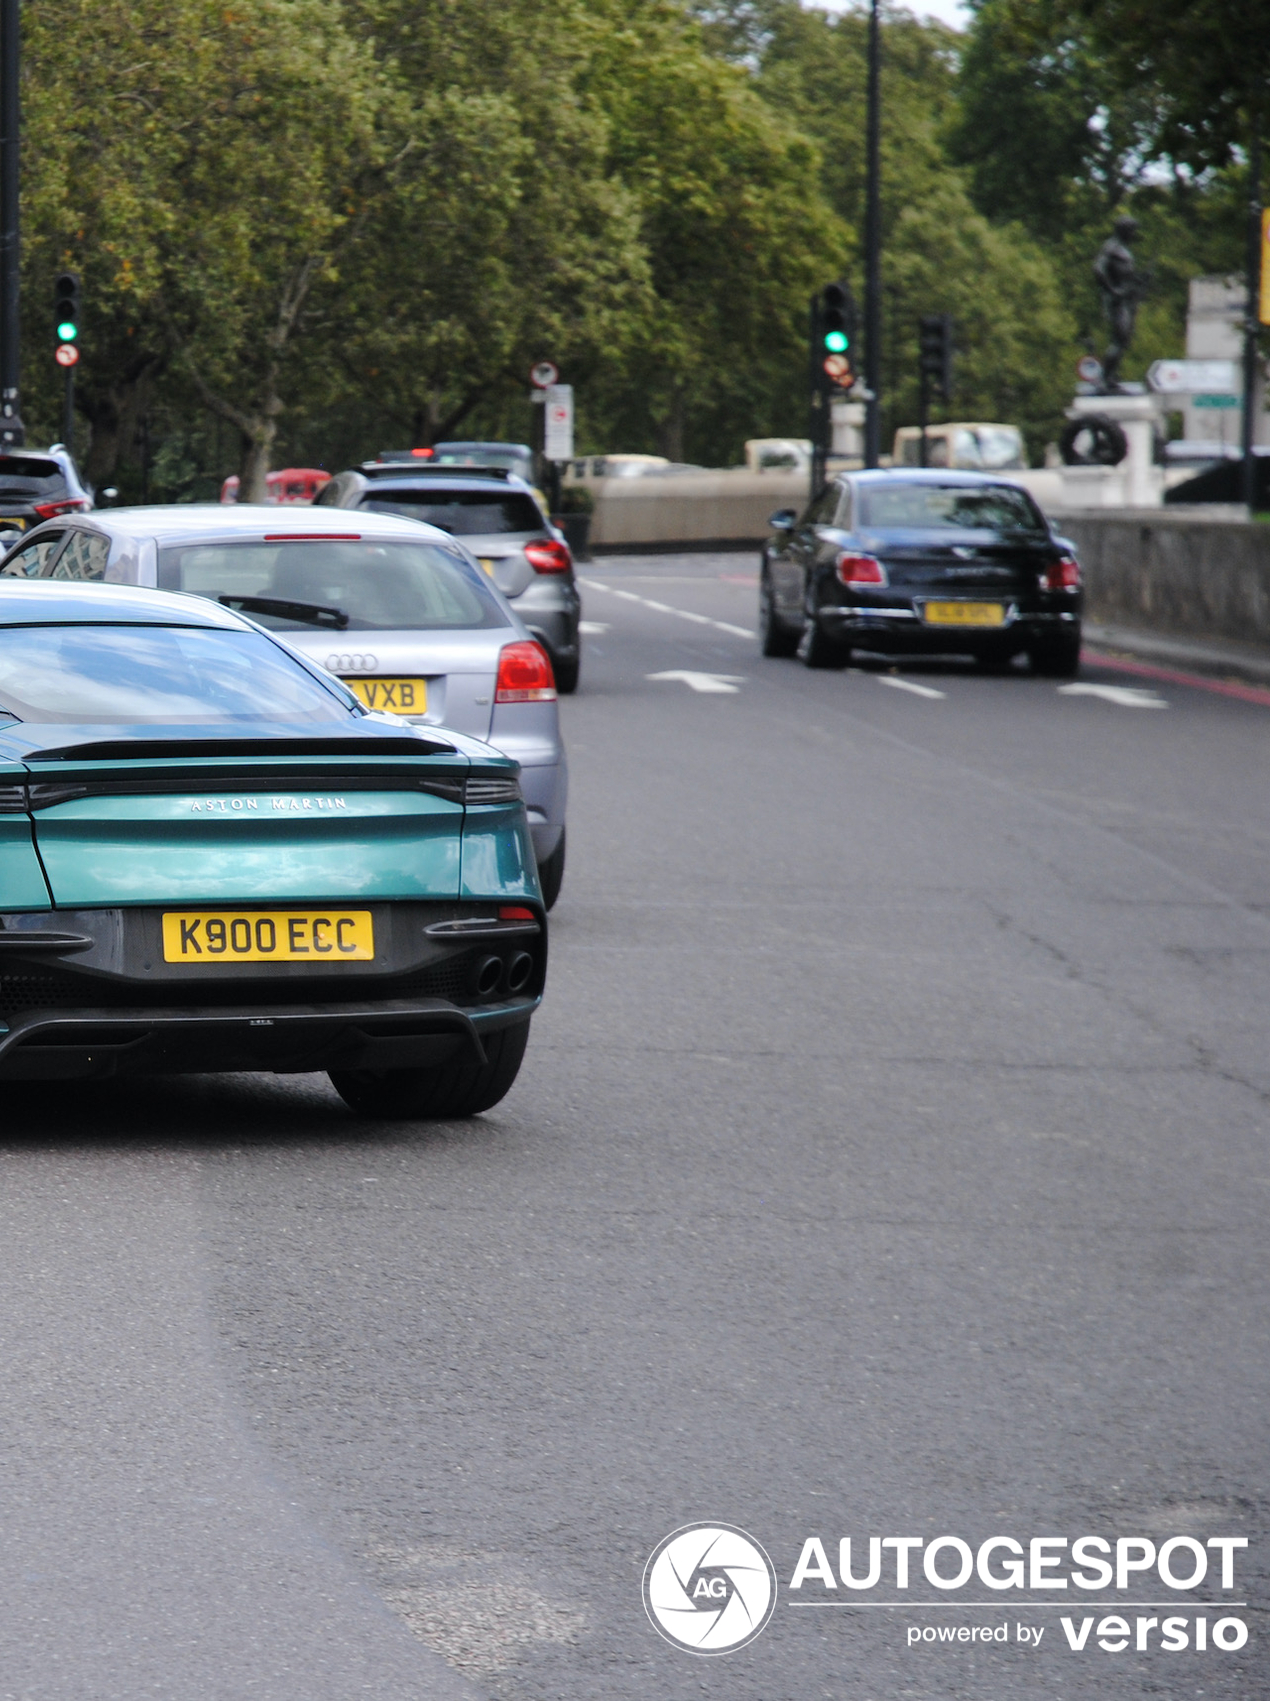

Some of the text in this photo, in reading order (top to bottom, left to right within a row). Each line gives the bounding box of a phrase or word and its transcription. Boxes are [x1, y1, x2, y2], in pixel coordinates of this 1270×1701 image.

[364, 684, 414, 707] VXB
[191, 797, 346, 812] ASTON MARTIN
[180, 918, 357, 954] K900 ECC
